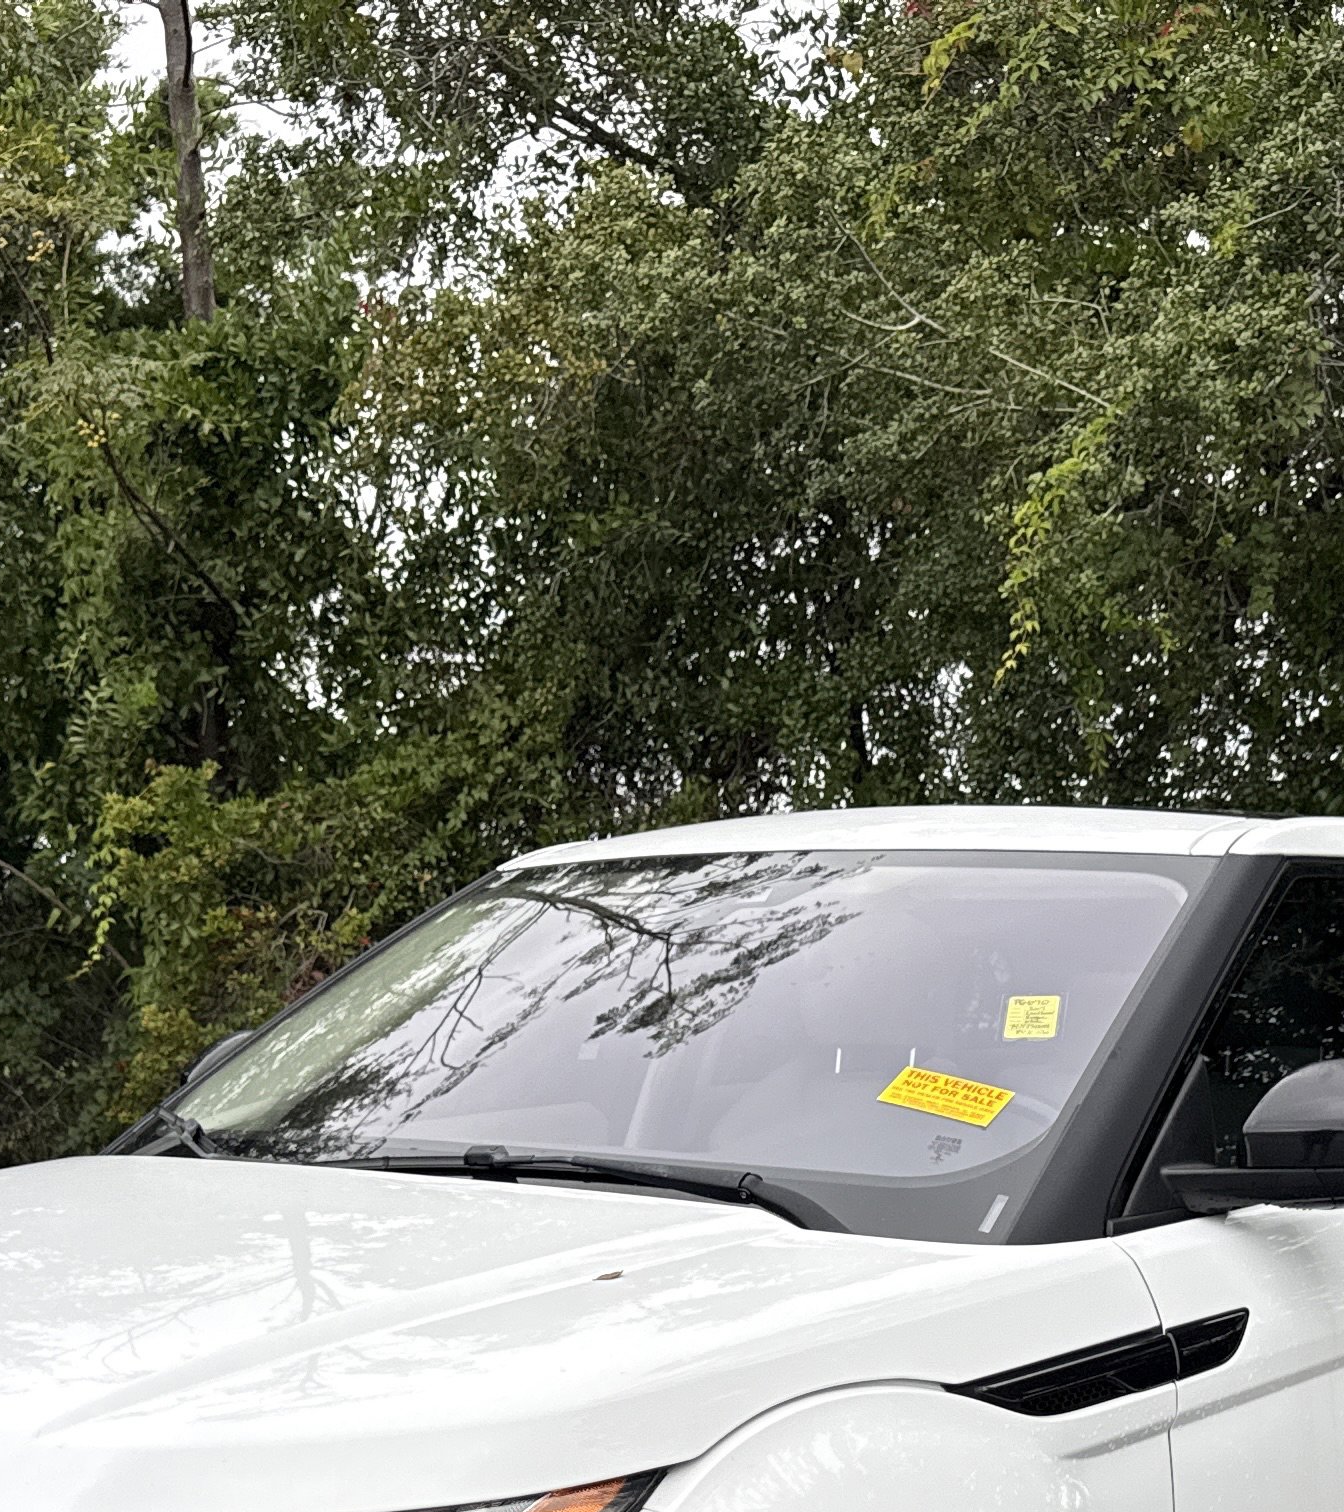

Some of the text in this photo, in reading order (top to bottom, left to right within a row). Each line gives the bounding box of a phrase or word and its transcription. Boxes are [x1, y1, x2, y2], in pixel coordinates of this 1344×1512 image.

[902, 1078, 931, 1092] NOT
[931, 1085, 959, 1099] FOR
[960, 1092, 998, 1108] SALE
[906, 1069, 940, 1084] THIS
[943, 1077, 1008, 1102] VEHICLE
